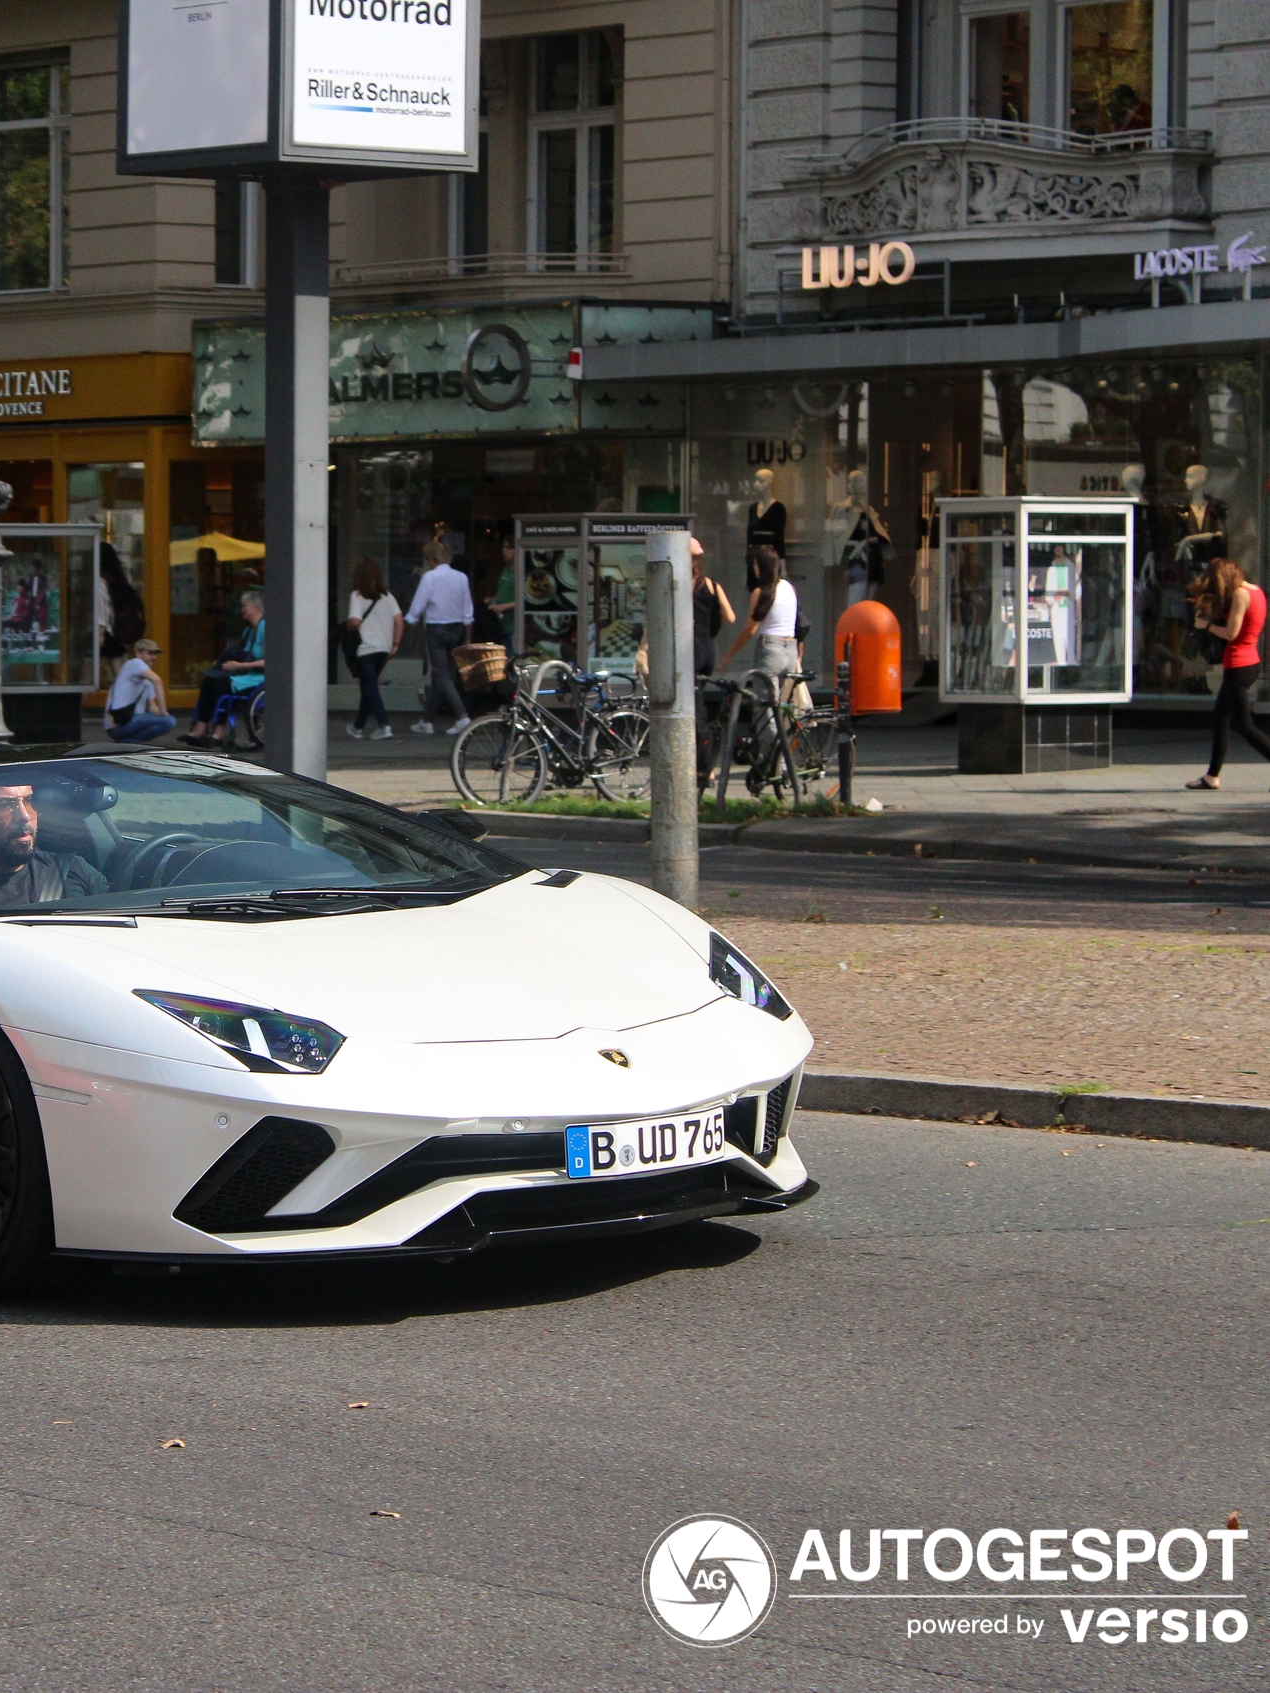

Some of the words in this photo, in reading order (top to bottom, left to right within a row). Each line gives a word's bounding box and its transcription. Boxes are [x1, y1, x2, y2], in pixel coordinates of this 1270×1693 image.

[187, 11, 212, 22] BERLIN
[308, 0, 451, 26] Motorrad
[375, 107, 451, 117] motorrad-berlin.com
[1134, 245, 1219, 280] LACOSTE
[329, 371, 464, 404] ALMERS
[591, 1131, 617, 1170] B
[638, 1123, 677, 1165] UD
[684, 1113, 723, 1158] 765
[575, 1157, 584, 1169] D
